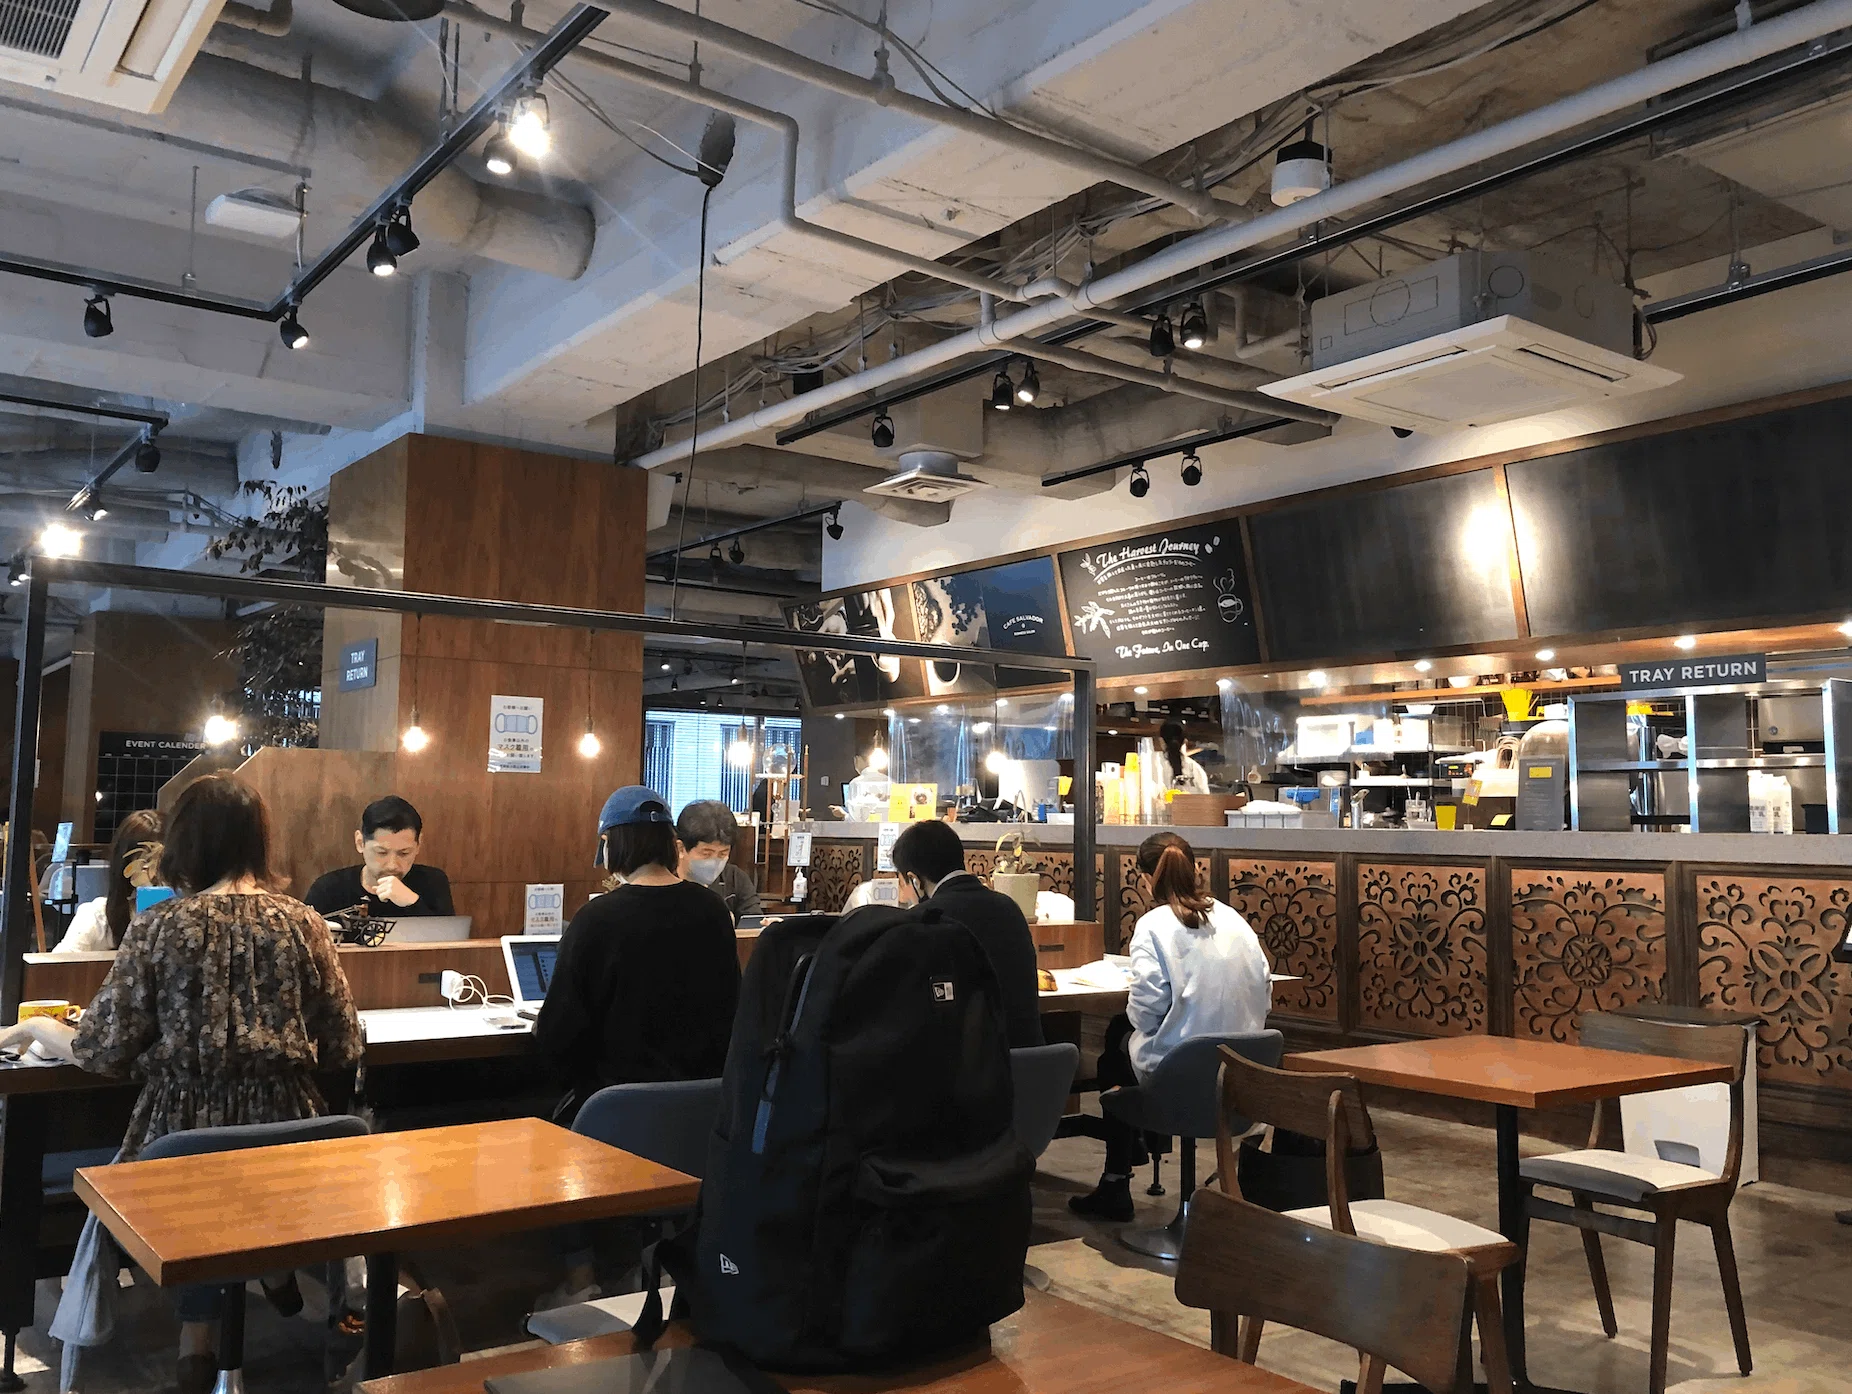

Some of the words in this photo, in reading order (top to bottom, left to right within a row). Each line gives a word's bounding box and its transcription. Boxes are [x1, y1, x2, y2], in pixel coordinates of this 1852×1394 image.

[1096, 552, 1119, 567] The
[1119, 543, 1157, 559] Harvest
[1158, 538, 1200, 555] Journey
[351, 650, 365, 663] TRAY
[1115, 645, 1132, 658] The
[346, 666, 368, 681] RETURN
[1629, 667, 1675, 683] TRAY
[1682, 661, 1757, 680] RETURN
[125, 740, 156, 748] EVENT
[158, 741, 206, 750] CALENDER
